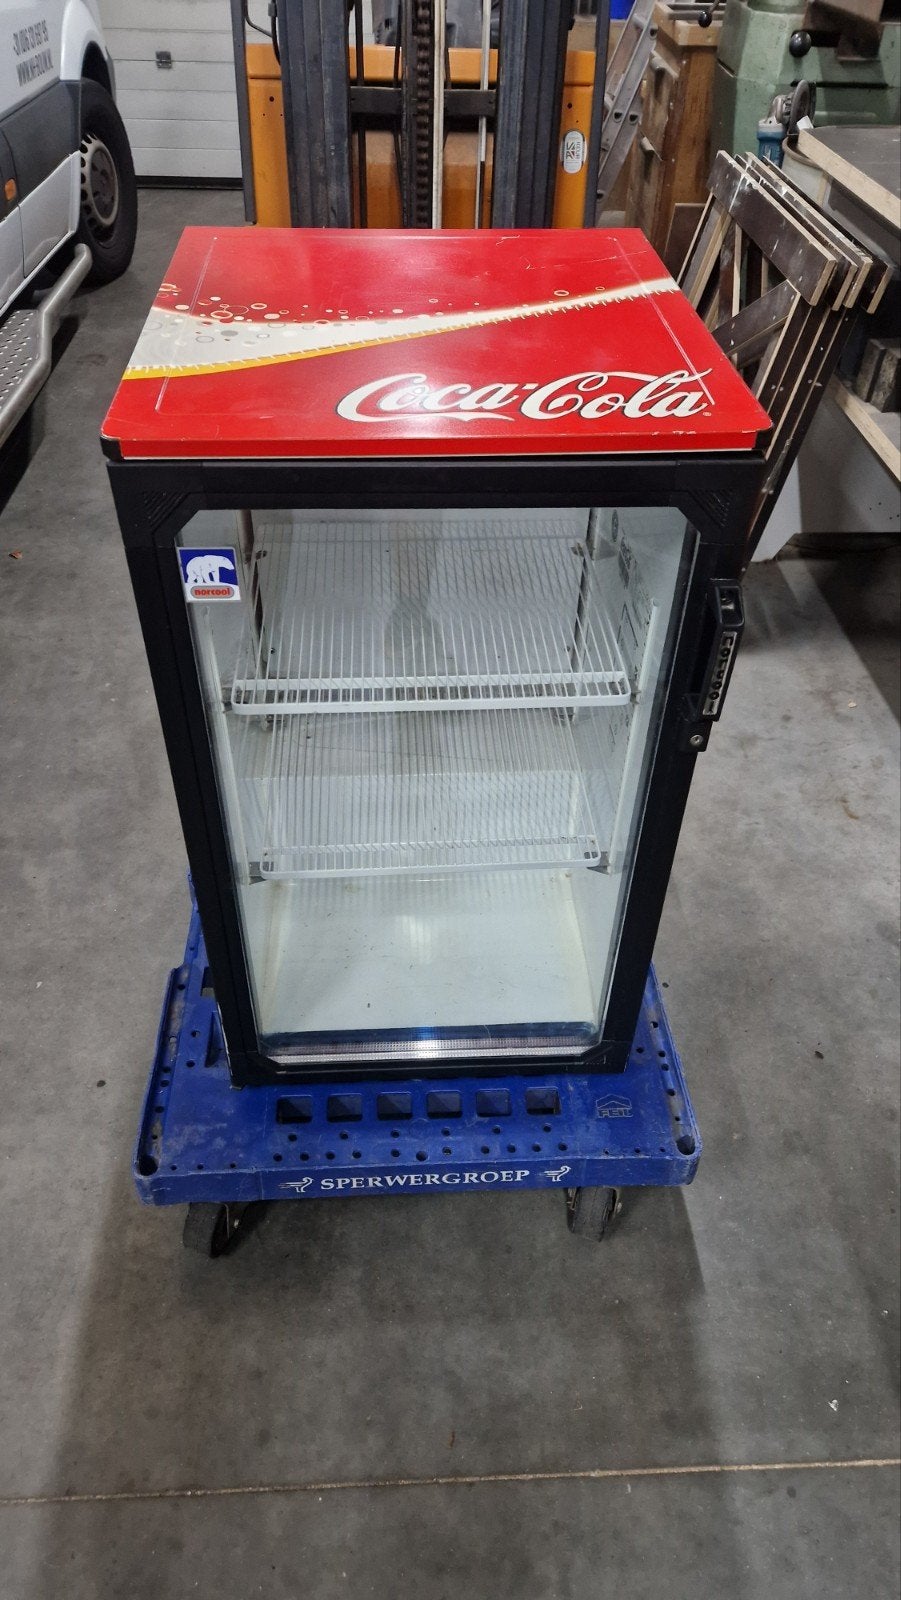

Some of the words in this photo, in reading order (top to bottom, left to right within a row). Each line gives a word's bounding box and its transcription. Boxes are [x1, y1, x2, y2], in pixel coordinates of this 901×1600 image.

[336, 368, 713, 423] Coca-Cola
[194, 587, 231, 596] norcool
[706, 635, 734, 712] norcool
[320, 1169, 530, 1190] SPERWERGROEP
